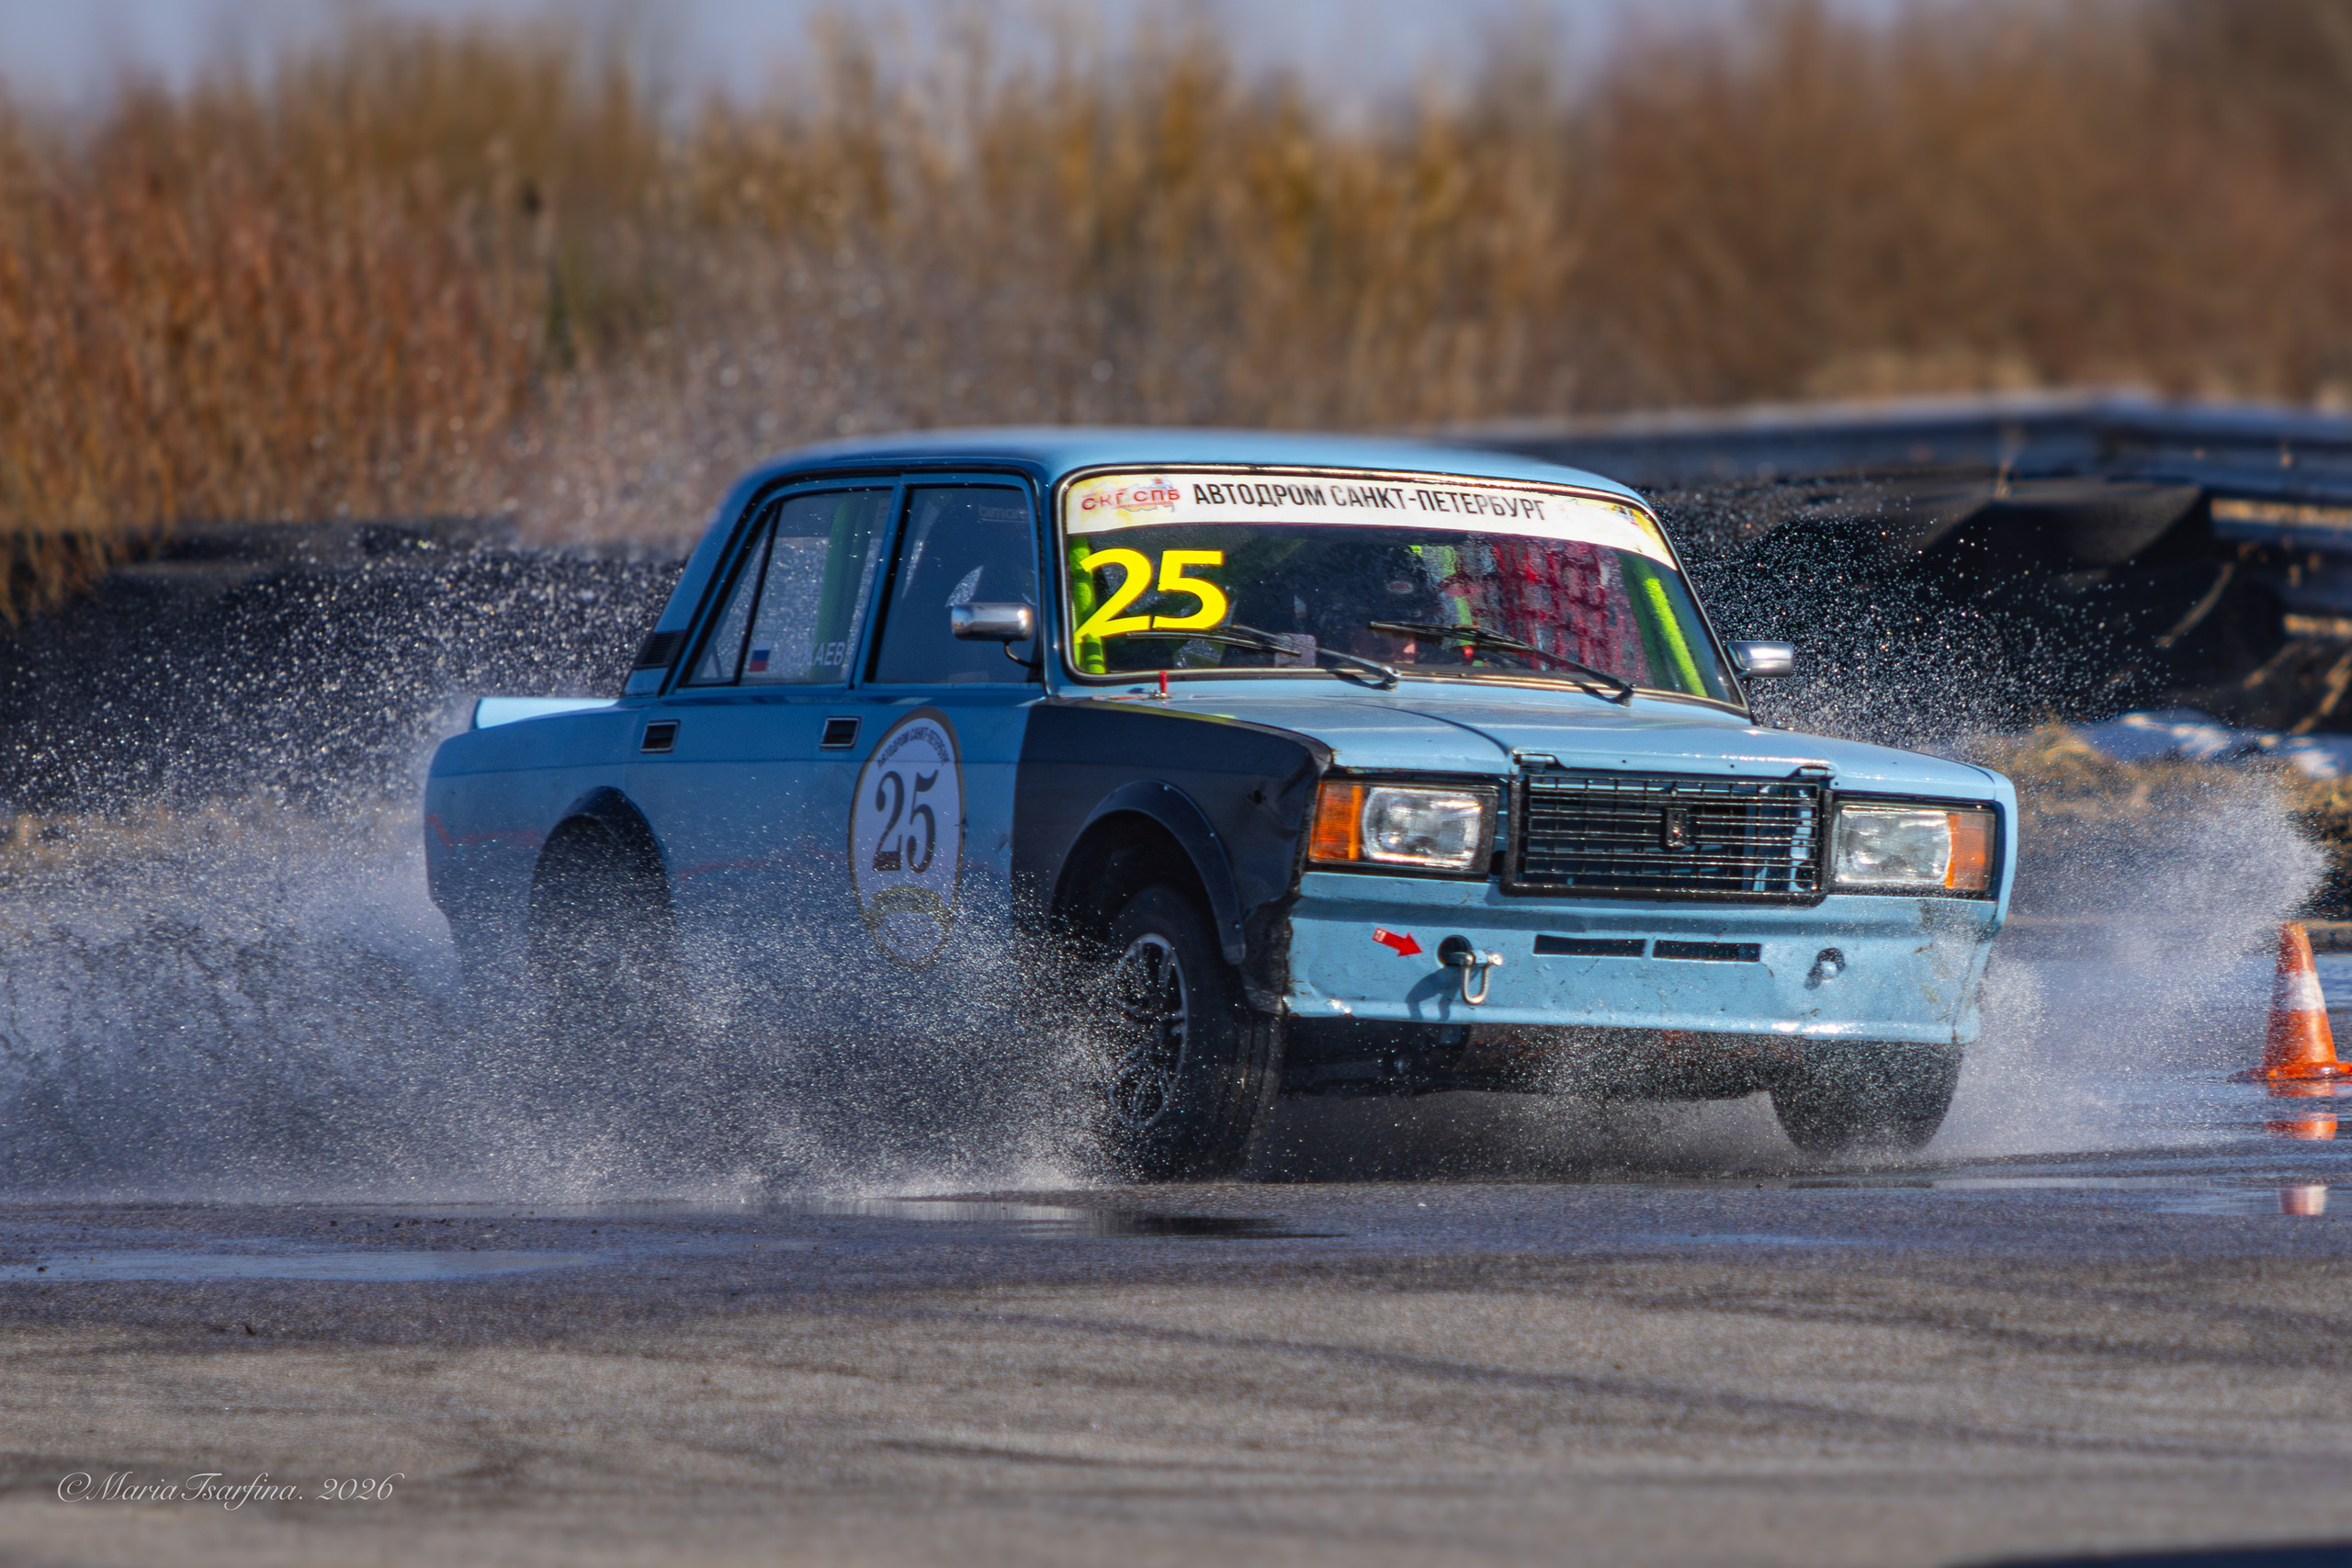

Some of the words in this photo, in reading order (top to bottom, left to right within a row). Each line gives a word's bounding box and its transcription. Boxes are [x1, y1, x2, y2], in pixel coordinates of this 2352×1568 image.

[1132, 488, 1181, 502] СПБ
[1193, 483, 1327, 507] АВТОДРОМ
[1331, 485, 1546, 521] САНКТ-ПЕТЕРБУРГ
[1073, 547, 1229, 644] 25
[872, 771, 939, 874] 25
